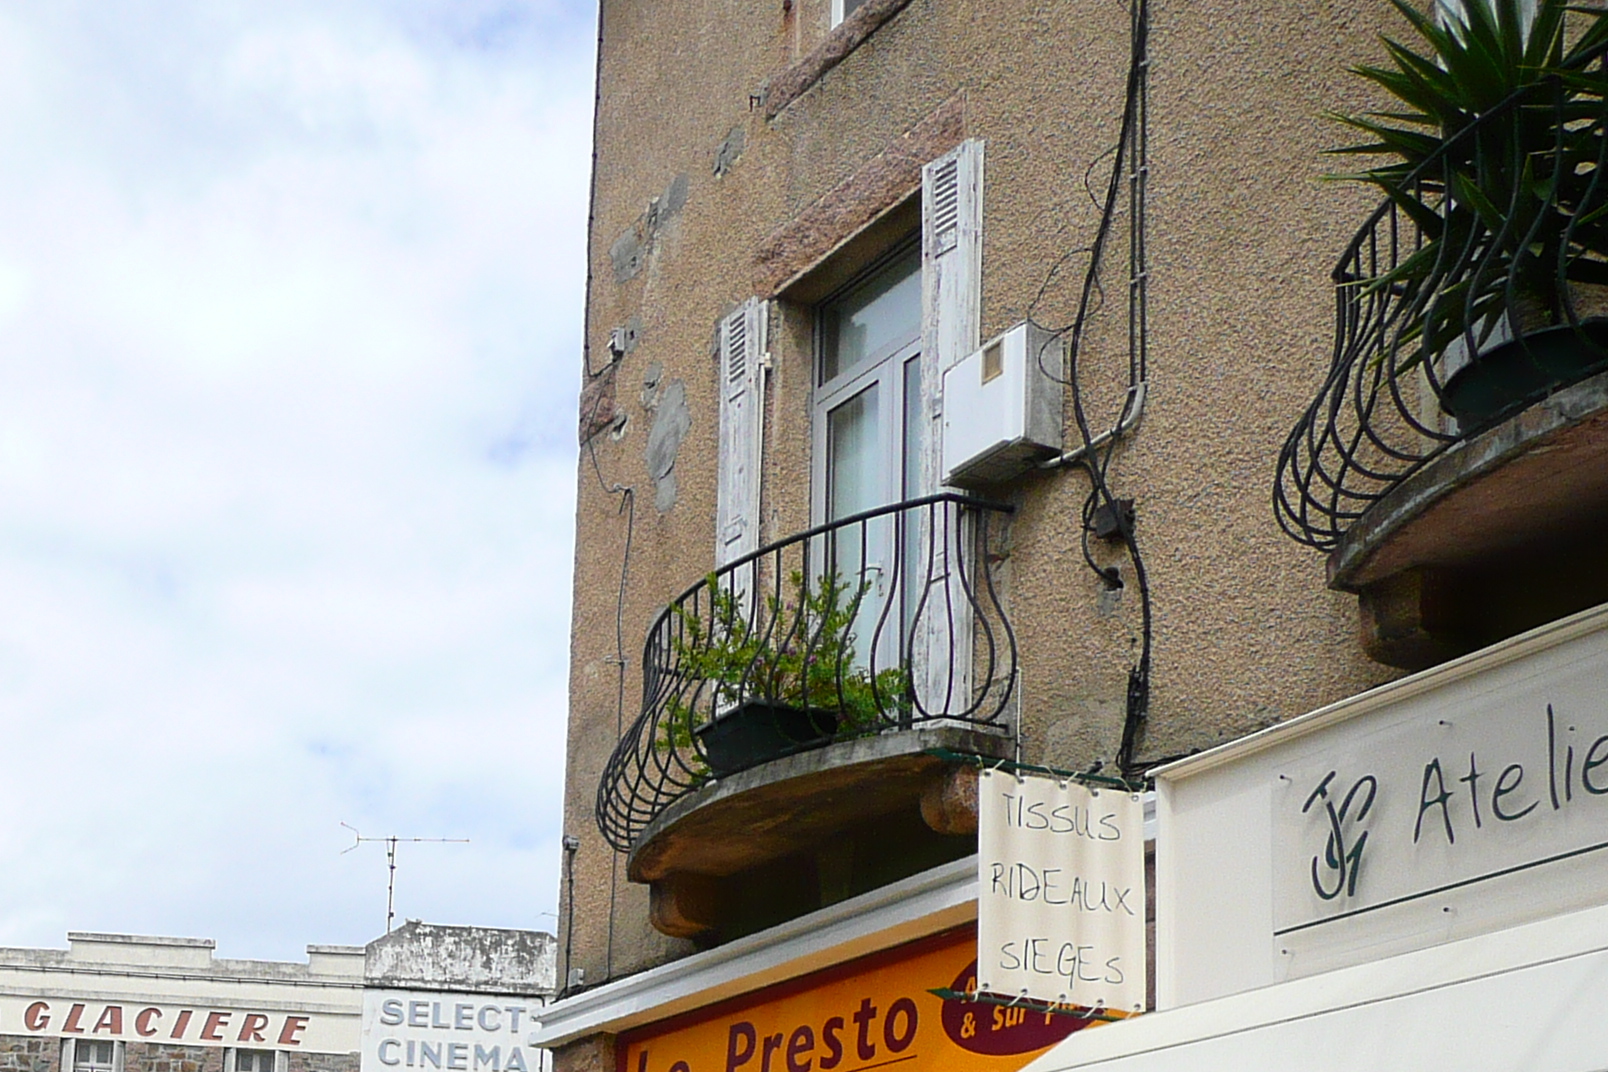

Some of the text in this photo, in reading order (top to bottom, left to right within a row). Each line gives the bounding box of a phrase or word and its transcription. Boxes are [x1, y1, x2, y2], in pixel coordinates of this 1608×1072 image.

[1002, 793, 1121, 841] TISSUS
[991, 862, 1134, 916] RIDEAUX
[999, 938, 1124, 990] SIEGES
[24, 1001, 310, 1045] GLACIERE
[380, 998, 527, 1033] SELECT
